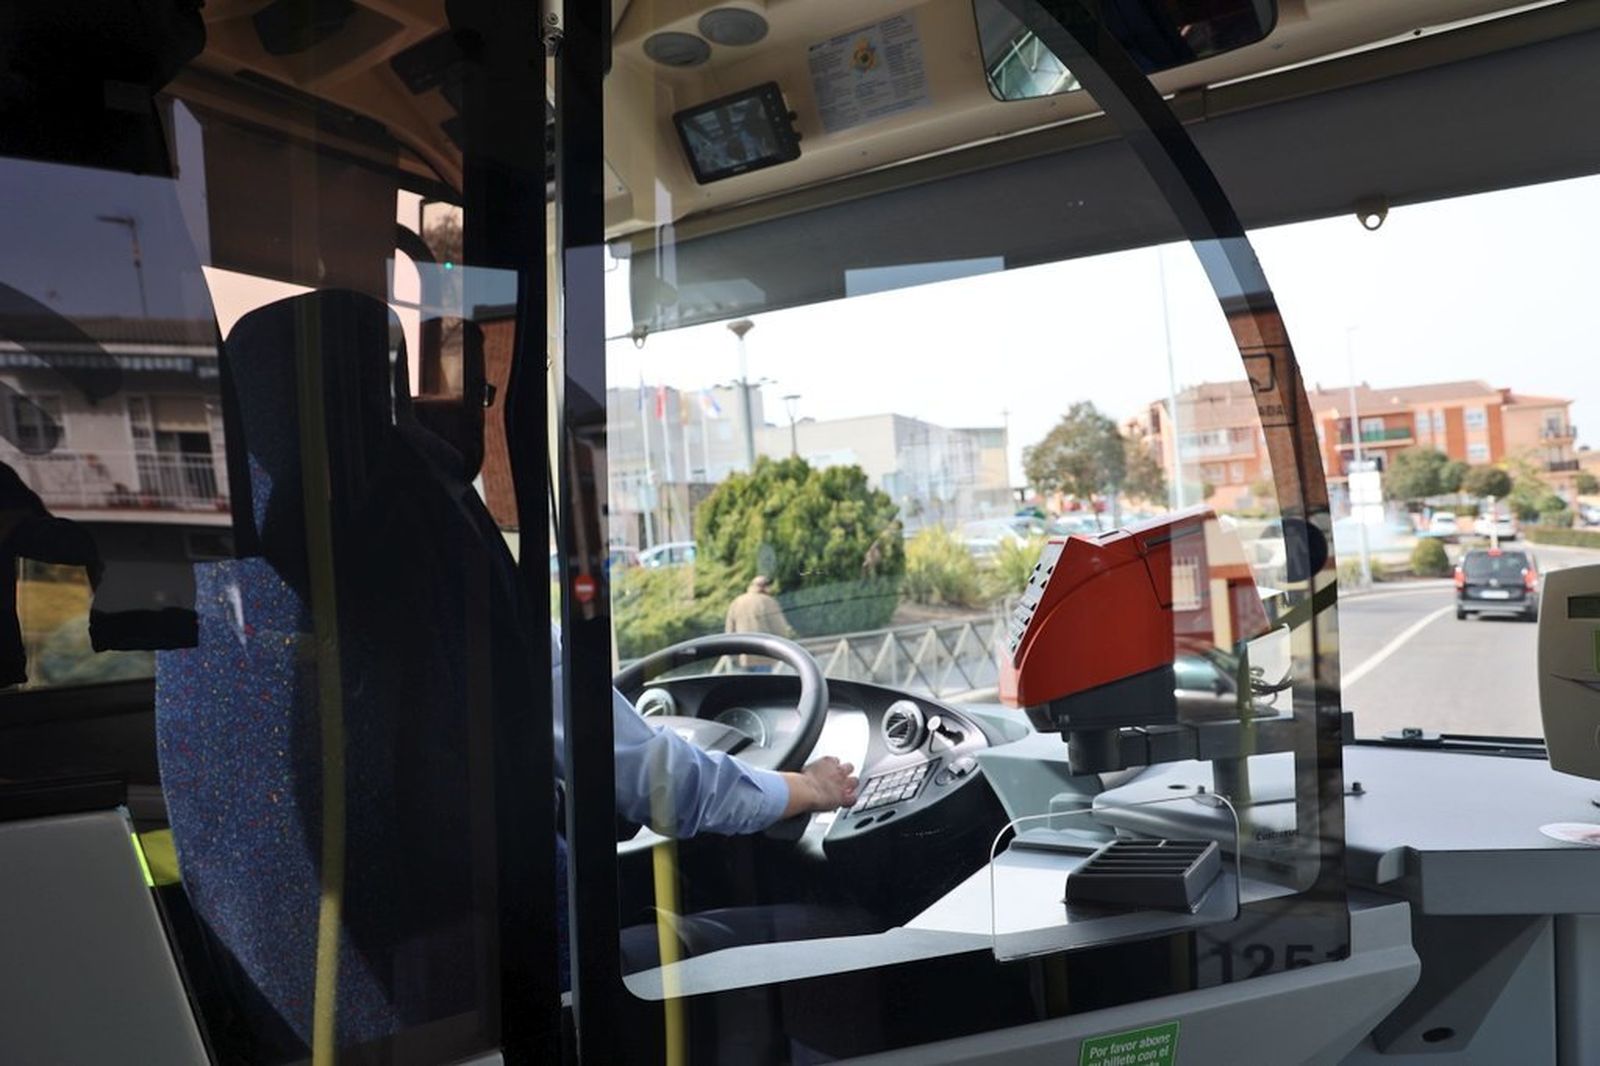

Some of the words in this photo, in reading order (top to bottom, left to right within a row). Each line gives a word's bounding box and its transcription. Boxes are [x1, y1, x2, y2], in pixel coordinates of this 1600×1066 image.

[1089, 1046, 1108, 1059] Por
[1110, 1041, 1137, 1055] favor
[1137, 1050, 1157, 1062] con
